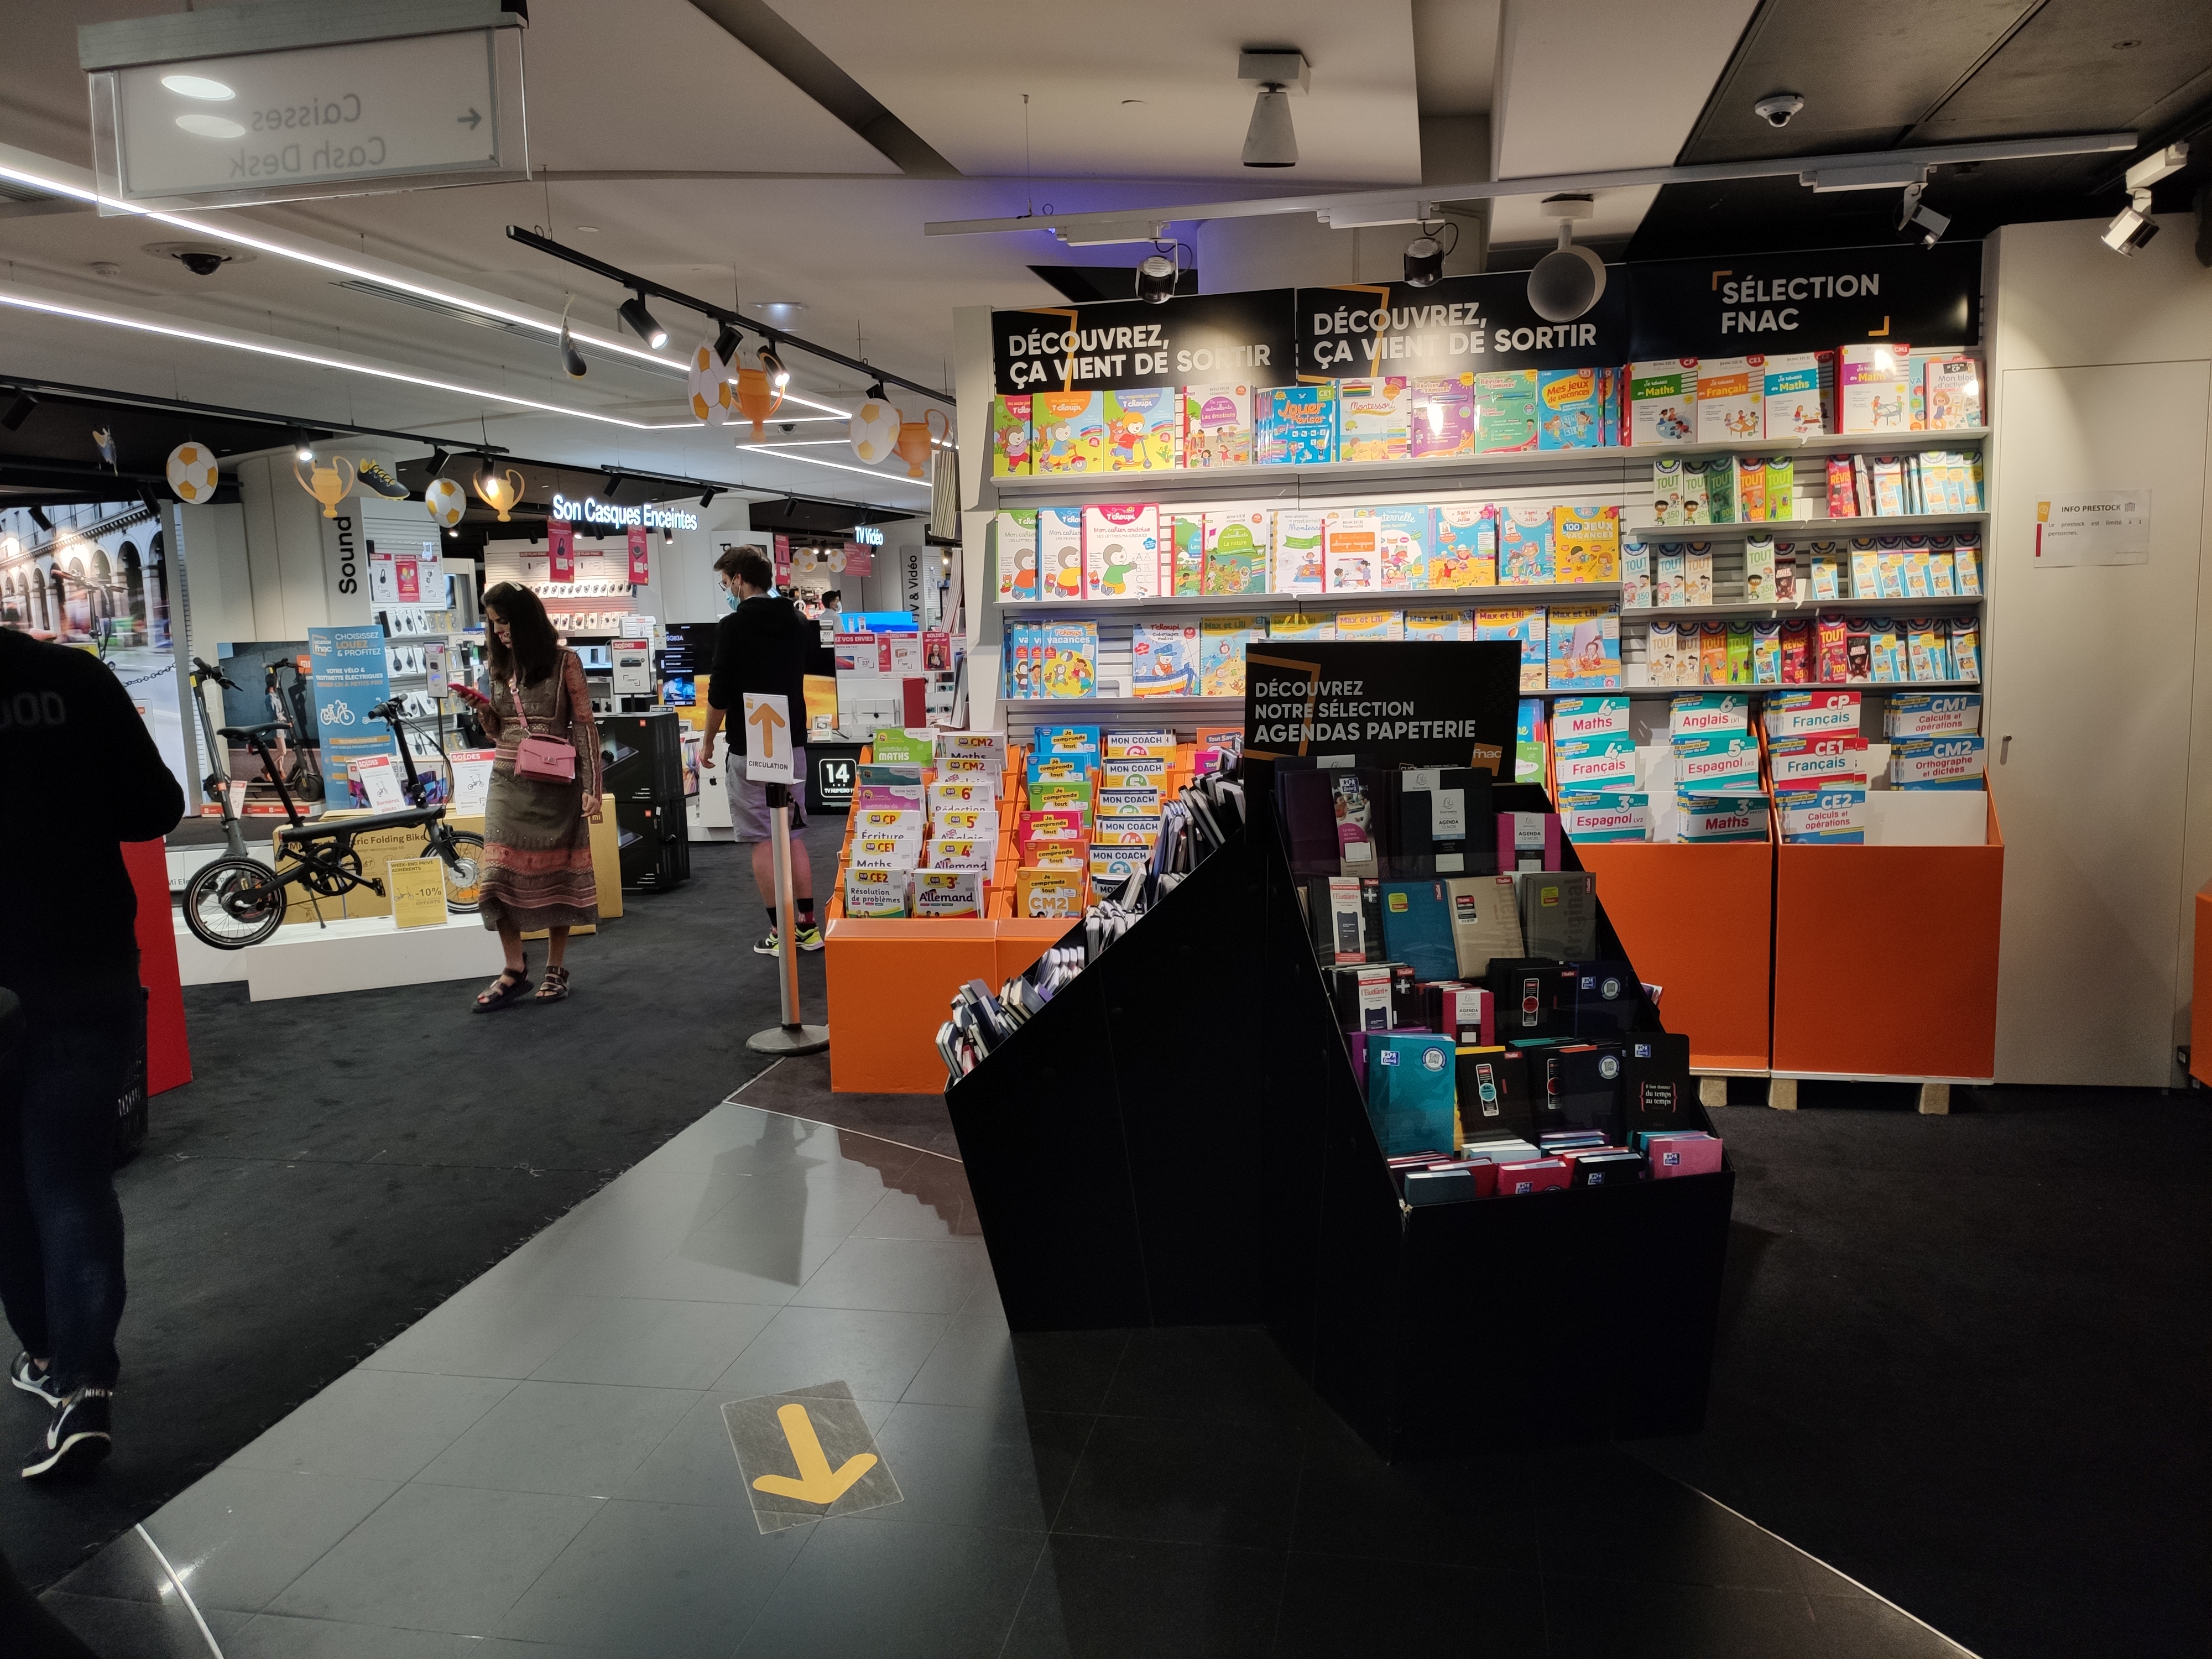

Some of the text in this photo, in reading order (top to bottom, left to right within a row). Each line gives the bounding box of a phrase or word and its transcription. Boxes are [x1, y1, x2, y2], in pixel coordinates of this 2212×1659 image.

[1722, 274, 1880, 304] SÉLECTION
[1313, 302, 1488, 335] DÉCOUVREZ,
[1721, 308, 1799, 333] FNAC
[1009, 325, 1170, 357] DÉCOUVREZ,
[1313, 324, 1597, 370] ÇA VIENT DE SORTIR
[1009, 345, 1271, 389] ÇA VIENT DE SORTIR
[1858, 373, 1886, 382] Maths
[1547, 380, 1589, 397] Mes jeux
[1646, 385, 1674, 397] Maths
[1707, 384, 1746, 397] Français
[1780, 380, 1809, 392] Maths
[1559, 389, 1589, 400] vacances
[1350, 401, 1396, 410] Montessori
[1656, 474, 1680, 490] TOUT
[553, 494, 697, 530] Son Casques Enceintes
[1667, 510, 1679, 519] 350
[1583, 521, 1613, 531] JEUX
[855, 527, 884, 546] TV Vidéo
[333, 517, 357, 594] Sound
[909, 555, 917, 589] Vidéo
[1636, 592, 1649, 601] 350
[335, 632, 379, 640] CHOISISSEZ
[1783, 636, 1808, 650] RÉVISE
[336, 640, 368, 649] LOUEZ
[345, 648, 381, 656] PROFITEZ
[1833, 664, 1845, 673] 700
[1255, 679, 1363, 697] DÉCOUVREZ
[1255, 699, 1414, 719] NOTRE SÉLECTION
[1827, 695, 1849, 711] CP
[1932, 697, 1967, 713] CM1
[1682, 713, 1729, 728] Anglais
[1793, 712, 1850, 728] Français
[1919, 714, 1952, 723] Calculs
[1254, 720, 1475, 743] AGENDAS PAPETERIE
[1915, 720, 1962, 732] opérations
[971, 738, 993, 747] CM2
[1473, 749, 1501, 759] fnac
[1934, 742, 1973, 758] CM2
[749, 761, 788, 770] CIRCULATION
[963, 762, 985, 771] CM2
[1573, 760, 1626, 775] Français
[1688, 757, 1743, 775] Espagnol
[1916, 757, 1973, 771] Orthographe
[1932, 766, 1965, 776] dictées
[826, 764, 849, 782] 14
[1822, 794, 1852, 810] CE2
[1577, 813, 1632, 828] Espagnol
[1806, 818, 1850, 830] opérations
[371, 836, 404, 844] Folding
[862, 830, 904, 839] Écriture
[870, 873, 888, 883] CE2
[415, 887, 441, 896] -10%
[919, 893, 974, 902] Allemand
